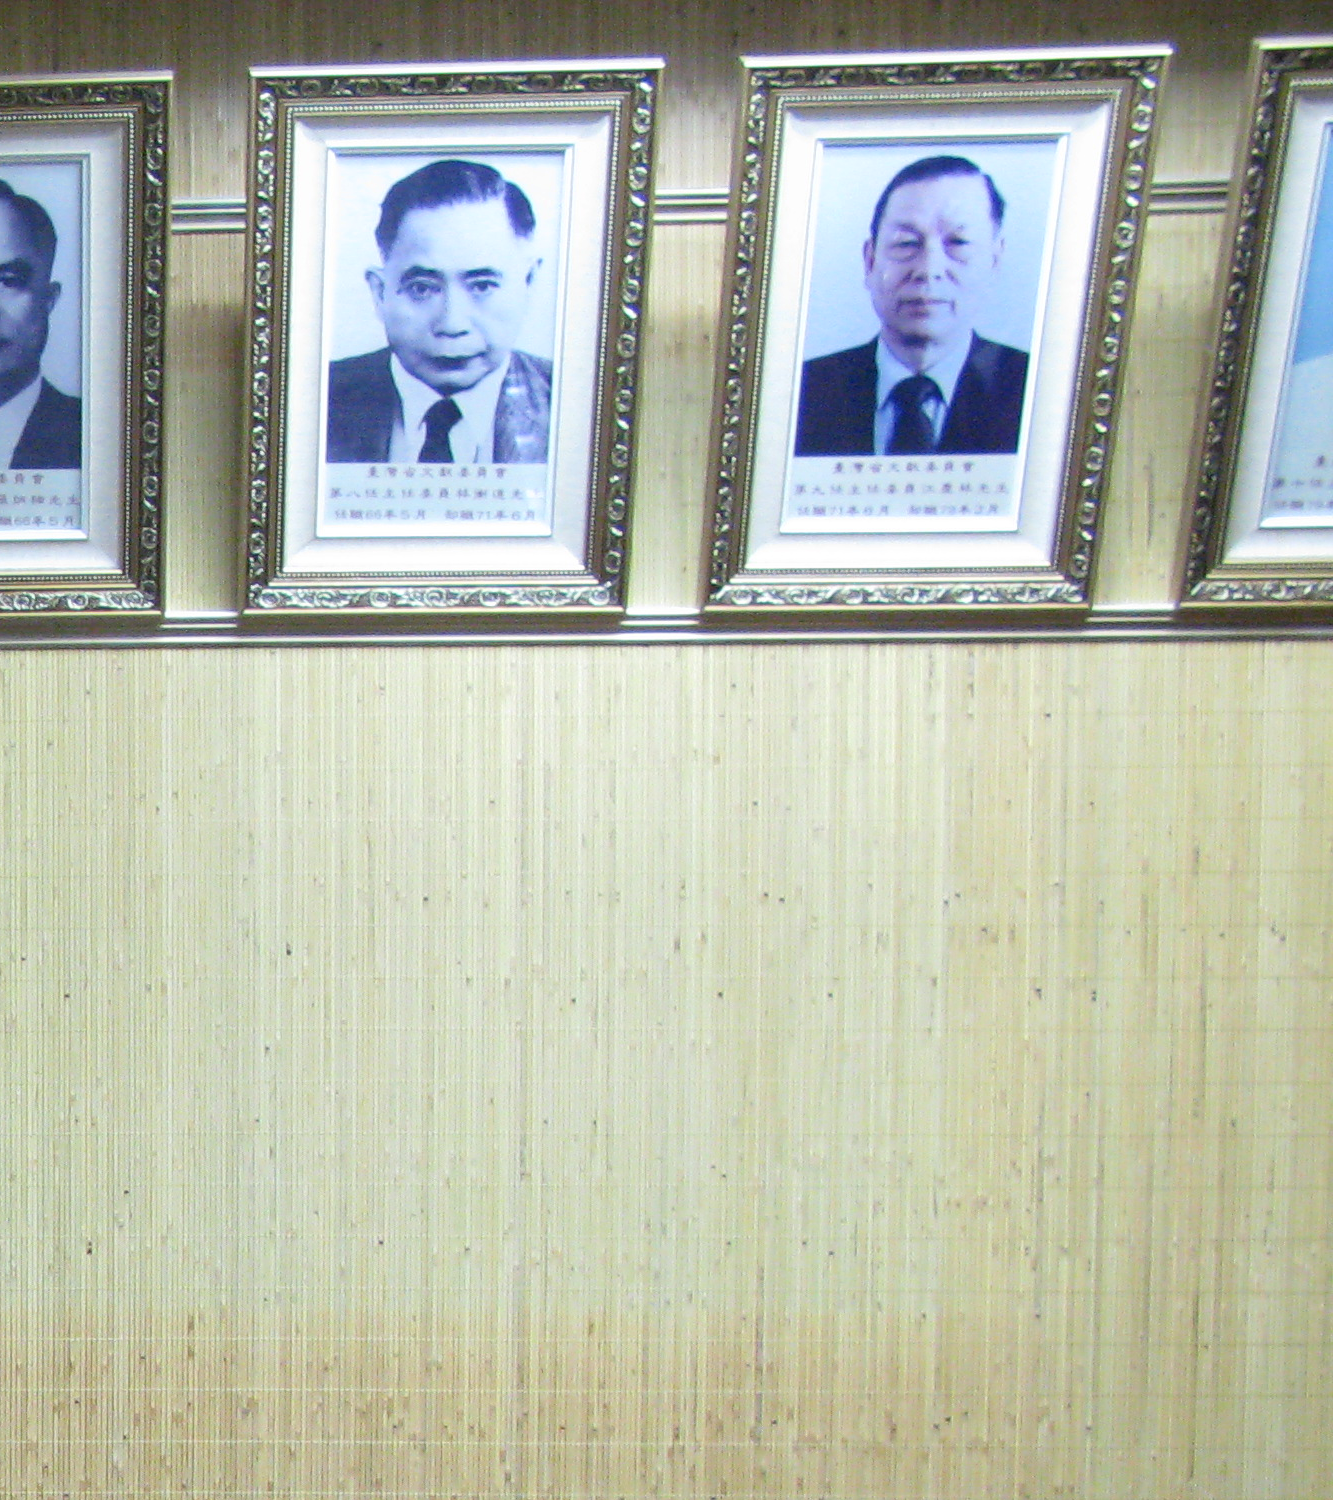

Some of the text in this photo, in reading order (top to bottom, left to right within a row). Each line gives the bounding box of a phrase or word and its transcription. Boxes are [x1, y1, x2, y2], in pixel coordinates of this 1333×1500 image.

[367, 466, 507, 479] 臺灣省文獻委員會
[833, 461, 975, 475] 臺灣省文獻委員會
[329, 487, 540, 500] 第八任主任委員林衡道先
